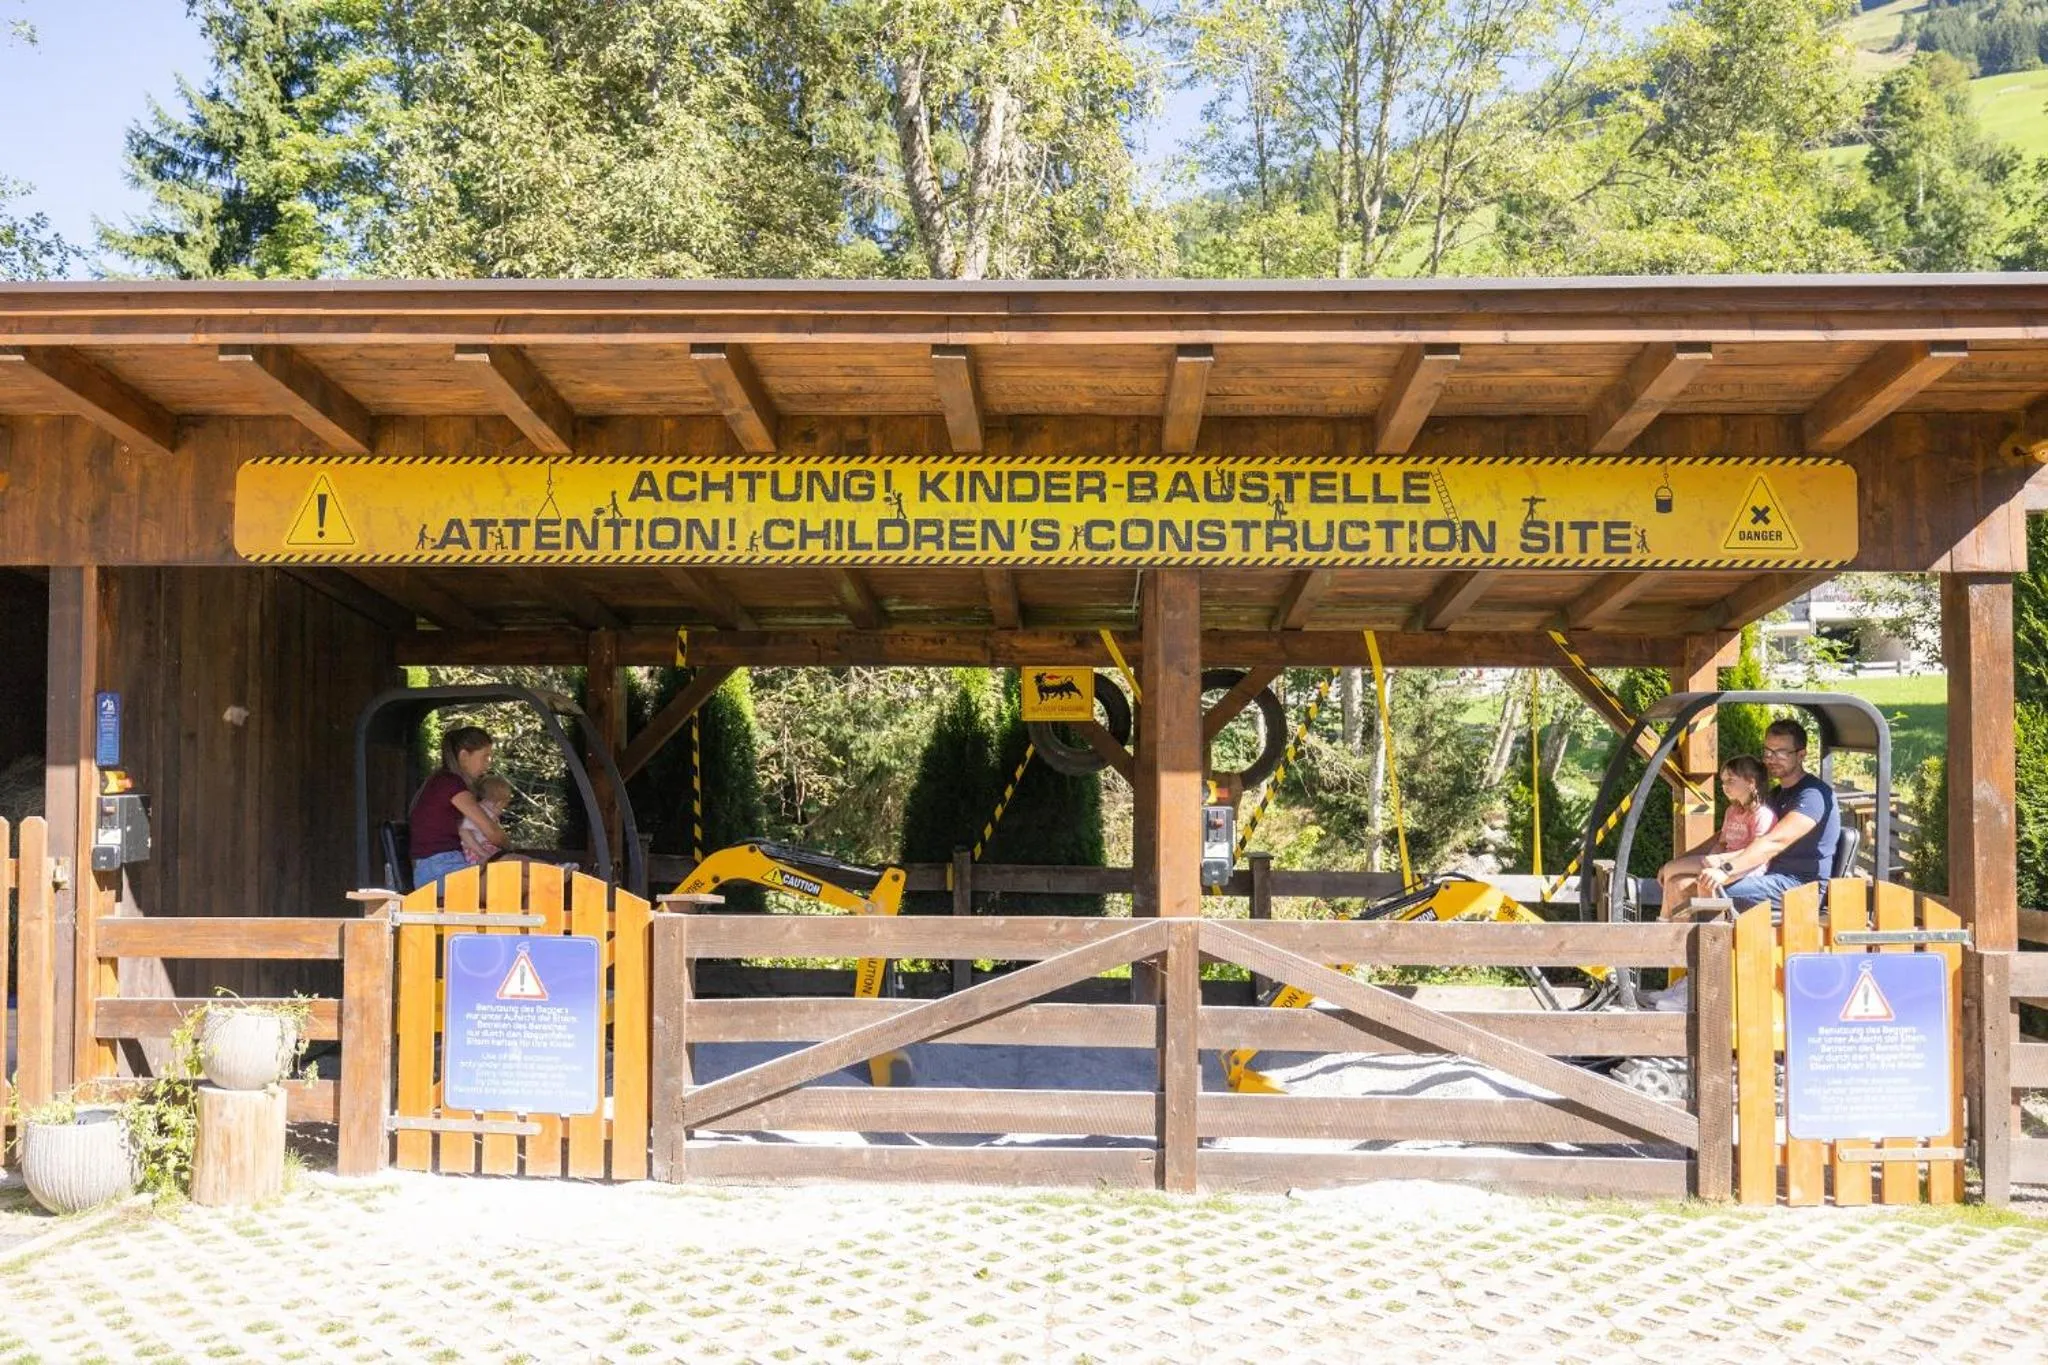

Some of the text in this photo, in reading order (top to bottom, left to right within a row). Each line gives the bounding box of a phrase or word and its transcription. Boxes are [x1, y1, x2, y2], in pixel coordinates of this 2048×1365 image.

[628, 469, 1432, 503] ACHTUNG! KINDER-BAUSTELLE
[432, 517, 1633, 554] ATTENTION! CHILDREN'S CONSTRUCTION SITE
[1738, 530, 1783, 541] DANGER
[783, 873, 820, 895] CAUTION
[862, 957, 878, 995] UTION
